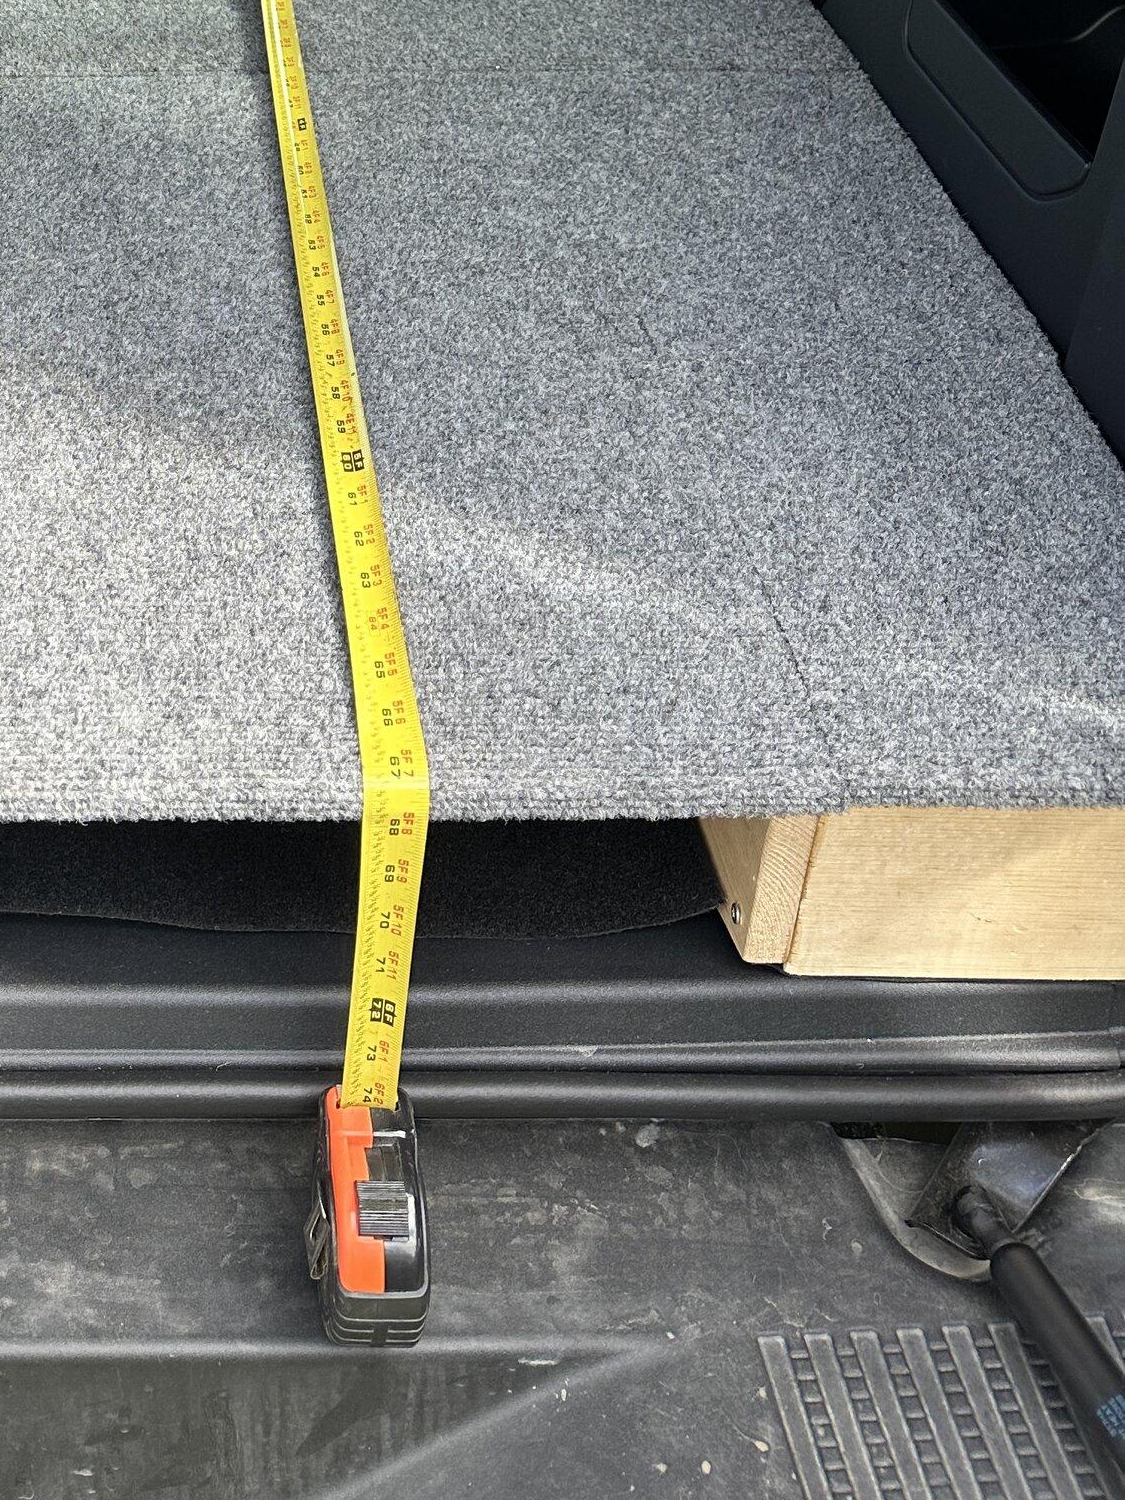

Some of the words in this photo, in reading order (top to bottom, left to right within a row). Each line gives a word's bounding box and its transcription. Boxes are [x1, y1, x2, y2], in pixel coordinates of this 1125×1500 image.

[312, 266, 320, 278] 54
[317, 294, 325, 306] 55
[321, 324, 329, 336] 56
[326, 354, 335, 367] 57
[331, 386, 340, 400] 58
[337, 420, 346, 434] 59
[348, 492, 357, 506] 61
[354, 531, 364, 547] 62
[360, 572, 371, 588] 63
[374, 661, 385, 679] 65
[382, 708, 393, 726] 66
[390, 756, 400, 779] 67
[389, 818, 401, 836] 68
[385, 865, 395, 883] 69
[380, 912, 390, 929] 70
[376, 958, 386, 973] 71
[371, 1001, 381, 1019] 72
[367, 1045, 377, 1061] 73
[362, 1088, 373, 1103] 74
